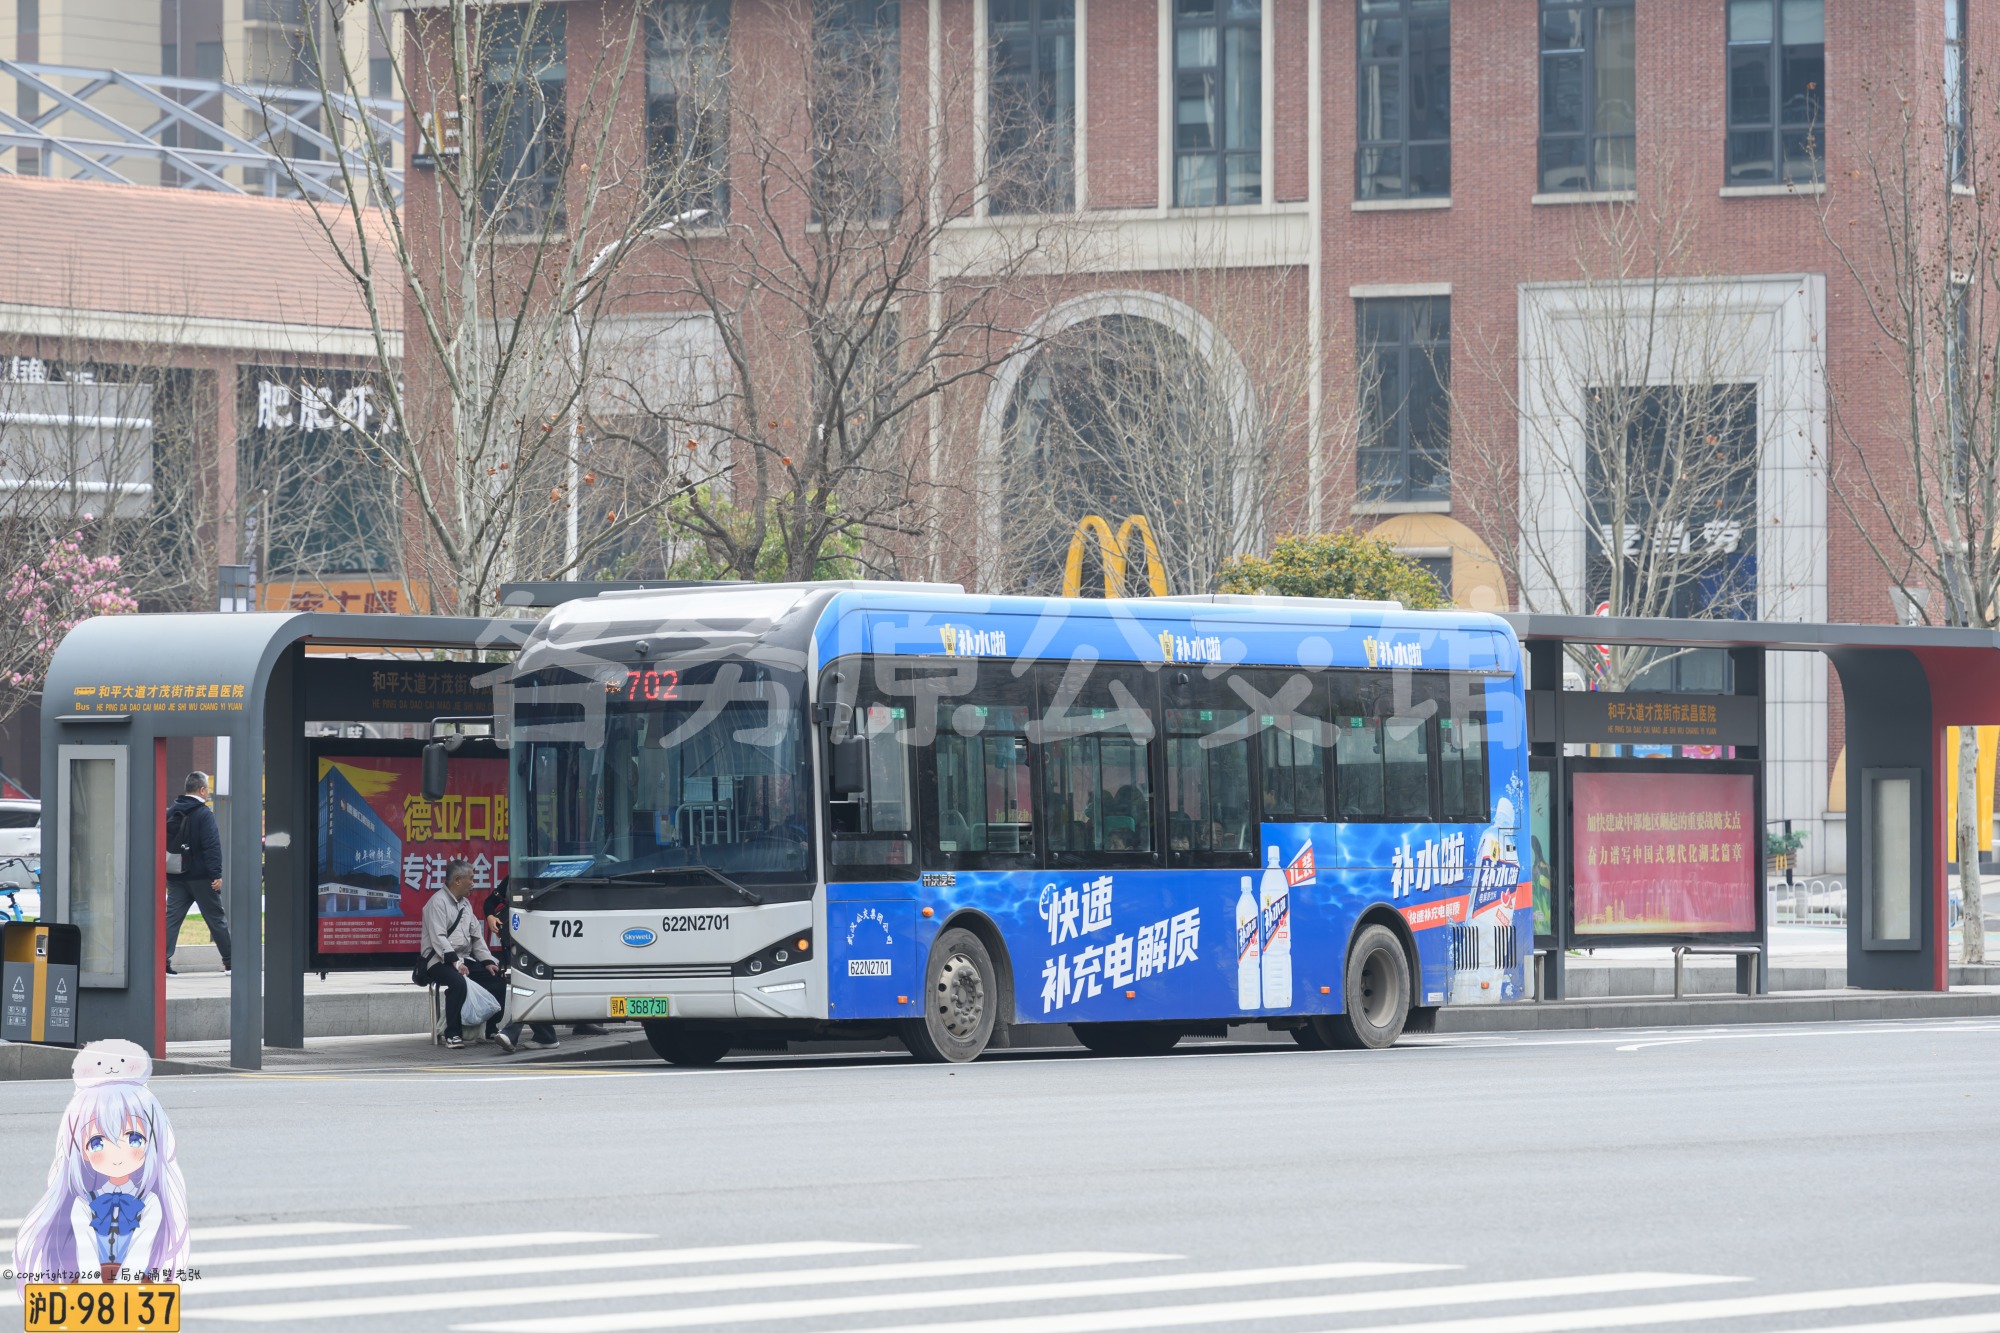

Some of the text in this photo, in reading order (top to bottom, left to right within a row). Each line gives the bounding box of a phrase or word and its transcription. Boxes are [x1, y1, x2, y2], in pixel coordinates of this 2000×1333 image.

[1601, 519, 1742, 555] 麦当劳
[957, 629, 1006, 656] 补水啦
[1175, 635, 1222, 661] 补水啦
[1379, 641, 1423, 667] 补水啦
[98, 684, 245, 699] 和平大道才茂街市武昌医院
[626, 669, 679, 700] 702
[75, 702, 243, 711] Bus HE PING DA DAO CAI MAO JIE SHI WU CHANG YI YUAN
[1608, 703, 1717, 723] 和平大道才茂街市武昌医院
[1587, 811, 1742, 832] 加快建成中部地区崛起的重要战略支点
[1391, 832, 1465, 899] 补水啦
[1587, 843, 1742, 865] 奋力谱写中国式现代化湖北篇章
[403, 853, 509, 890] 专注全
[922, 873, 956, 887] 开沃汽车
[1480, 860, 1519, 892] 补水啦
[662, 914, 730, 932] 622N2701
[1048, 875, 1113, 946] 快速
[1409, 901, 1460, 925] 快速补充电解质
[550, 920, 584, 938] 702
[850, 960, 890, 975] 622N2701
[1041, 907, 1200, 1014] 补充电解质
